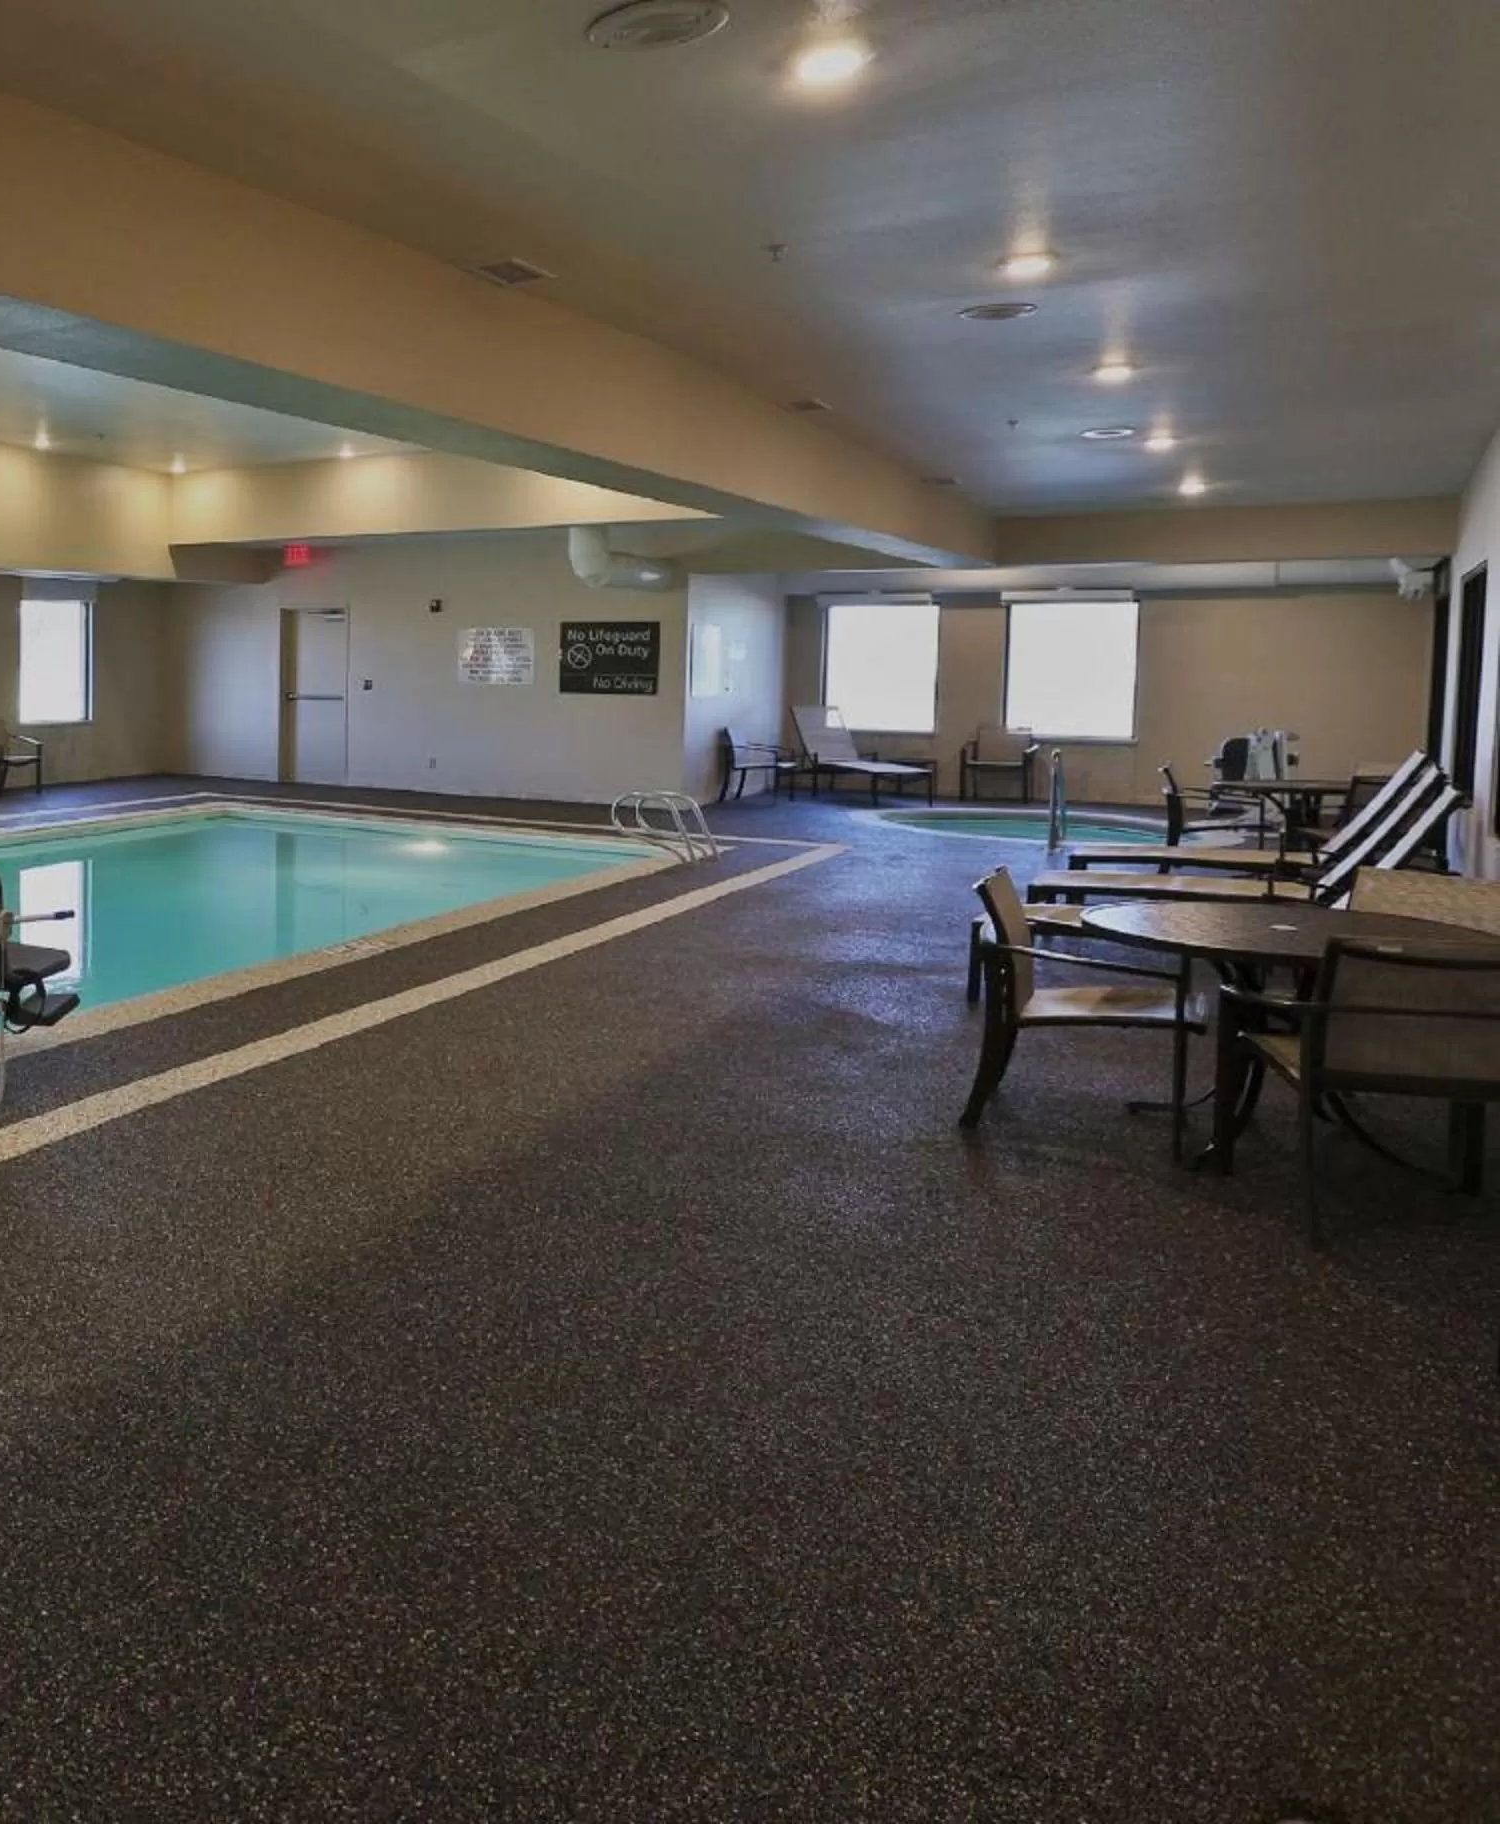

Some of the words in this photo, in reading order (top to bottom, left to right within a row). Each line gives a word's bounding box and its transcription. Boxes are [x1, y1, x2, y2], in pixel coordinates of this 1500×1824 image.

[567, 630, 586, 641] No
[589, 628, 651, 644] Lifeguard
[596, 643, 615, 656] On
[618, 643, 650, 660] Duty
[593, 676, 611, 689] No
